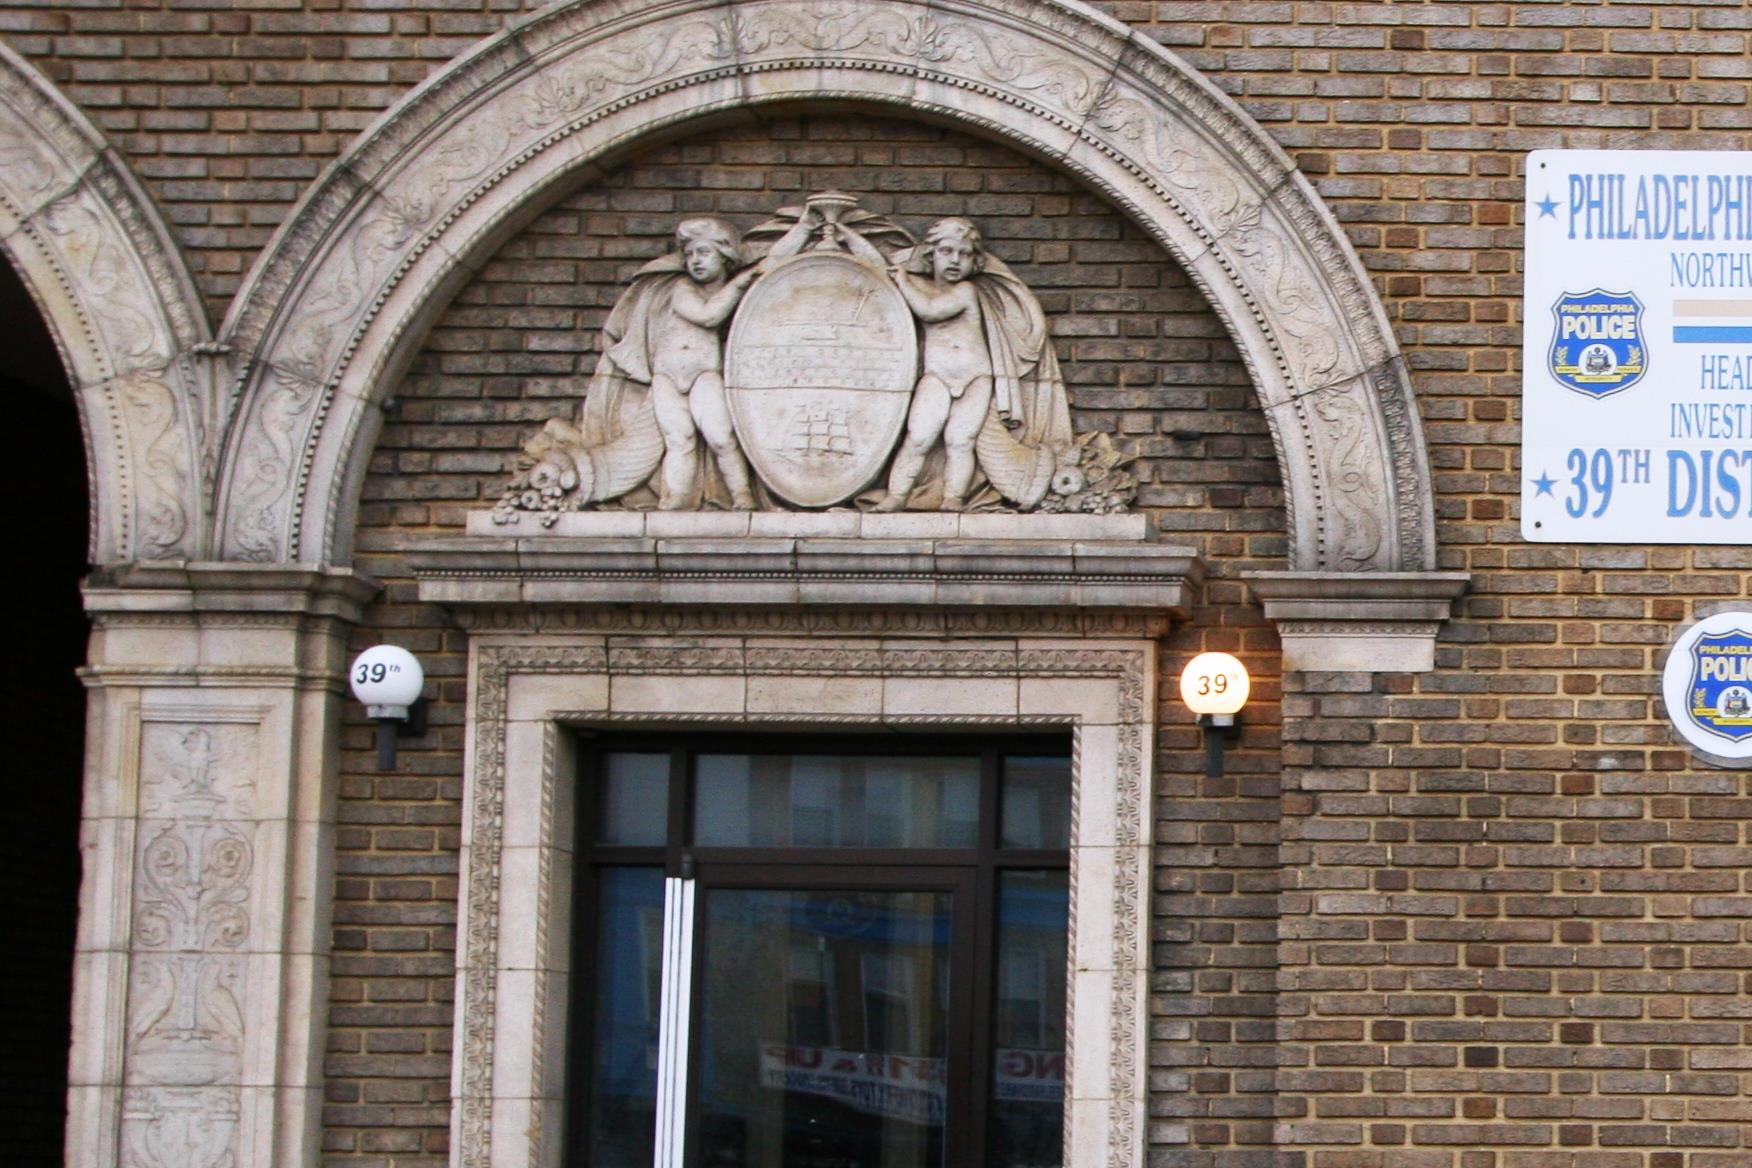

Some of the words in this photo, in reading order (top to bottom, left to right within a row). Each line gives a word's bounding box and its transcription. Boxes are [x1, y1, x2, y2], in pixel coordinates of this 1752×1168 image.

[1560, 304, 1635, 313] PHILADELPHIA
[1562, 315, 1635, 339] POLICE
[356, 663, 402, 684] 39th
[1197, 673, 1239, 695] 39
